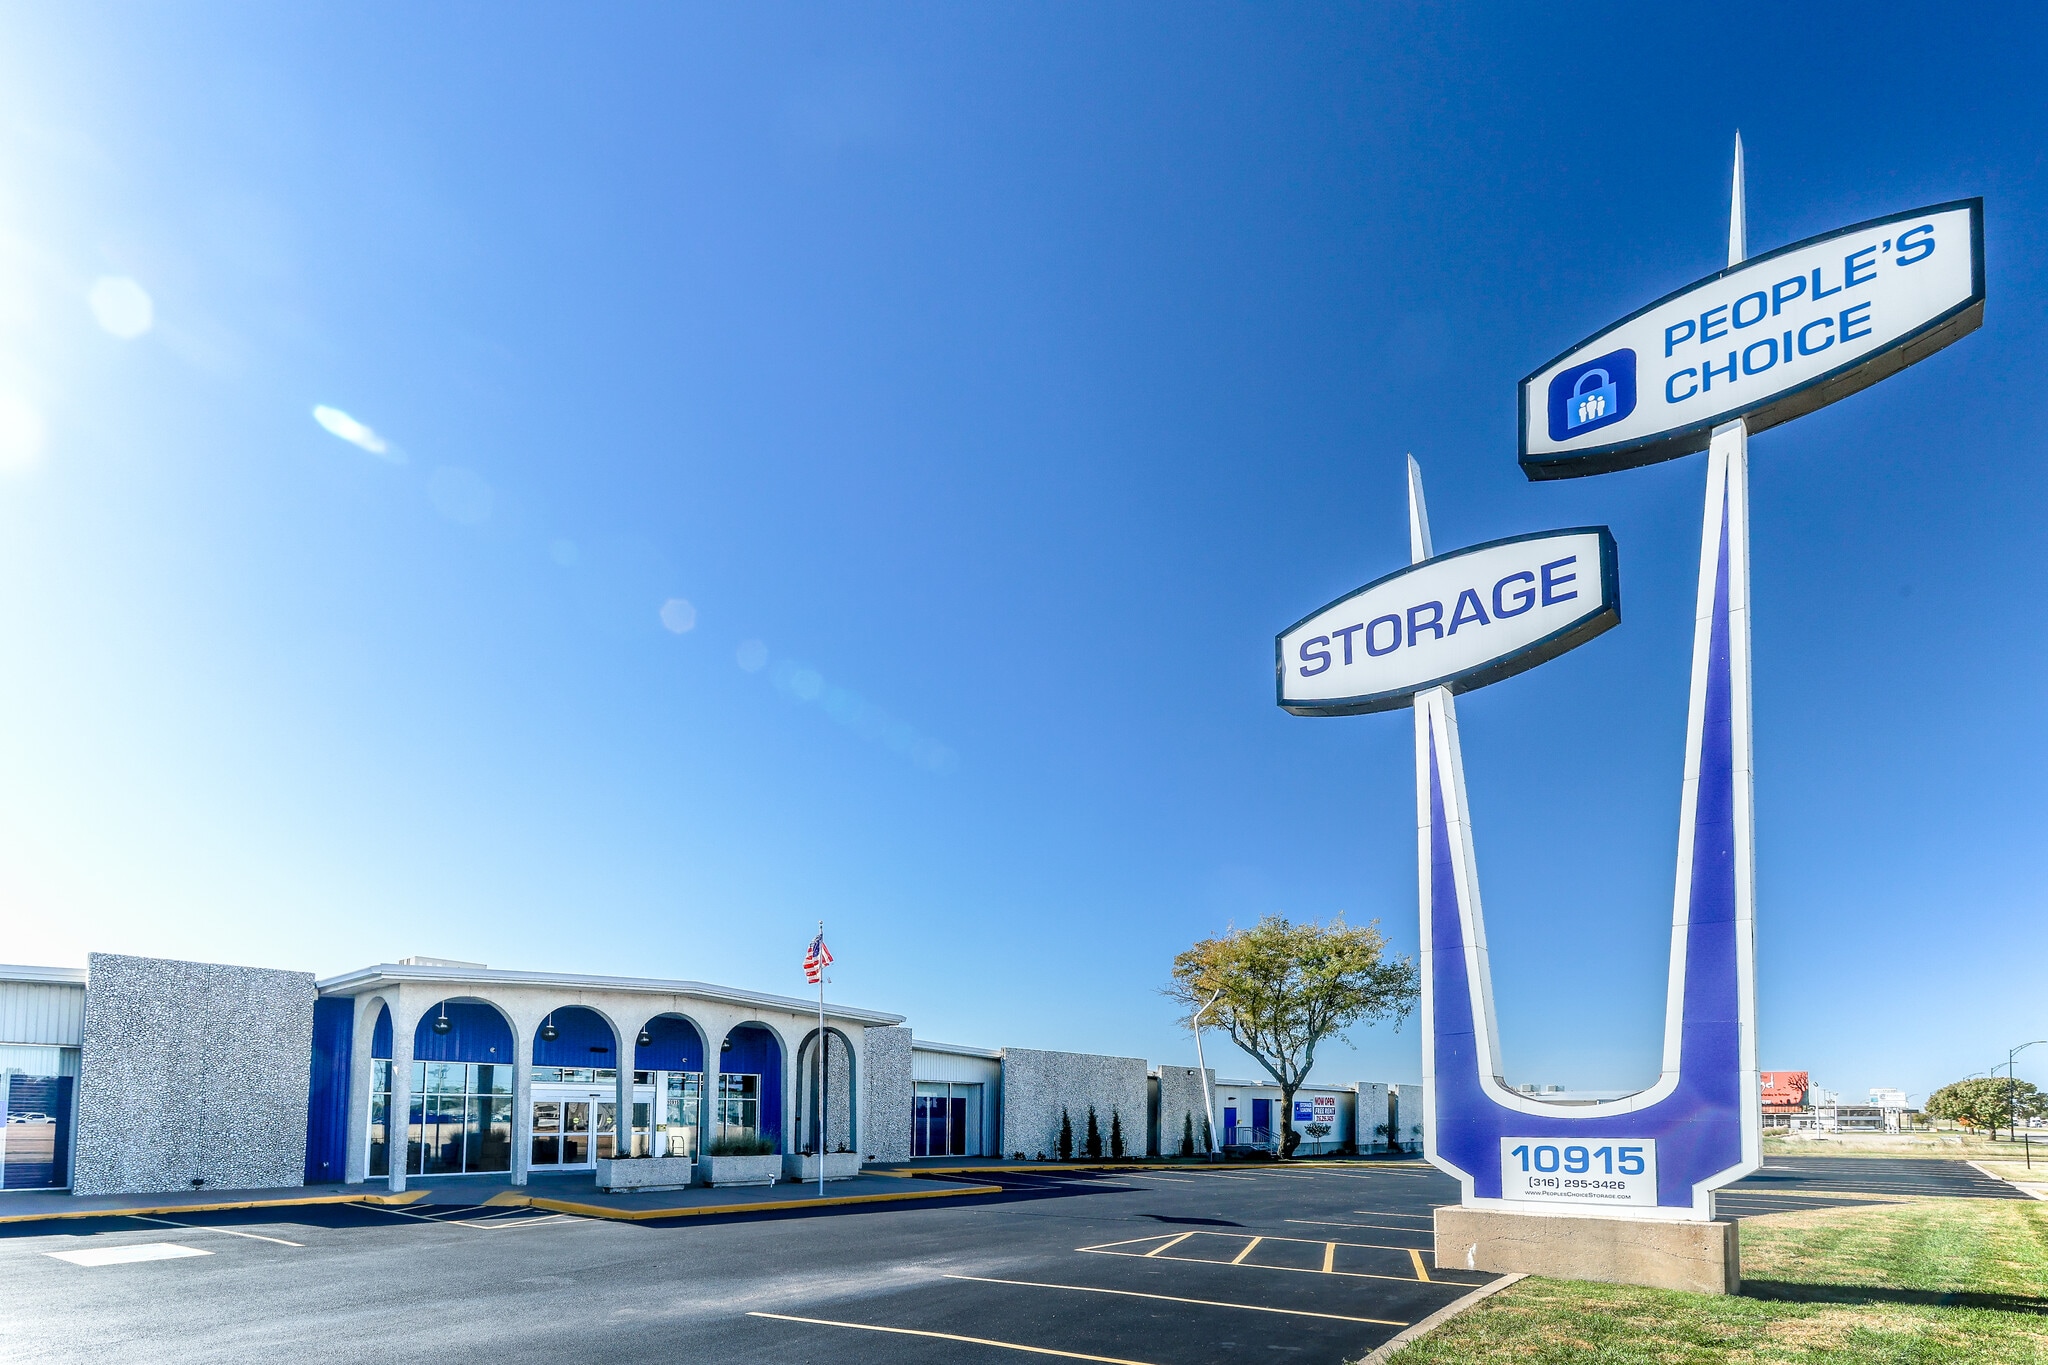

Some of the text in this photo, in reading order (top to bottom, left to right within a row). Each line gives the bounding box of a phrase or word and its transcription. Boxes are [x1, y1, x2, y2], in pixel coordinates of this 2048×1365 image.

[1664, 223, 1936, 359] PEOPLE'S
[1664, 300, 1873, 404] CHOICE
[1299, 554, 1578, 678] STORAGE
[1315, 1097, 1335, 1106] NOW OPEN
[1511, 1145, 1645, 1175] 10915
[1528, 1176, 1626, 1190] (316) 295-3426
